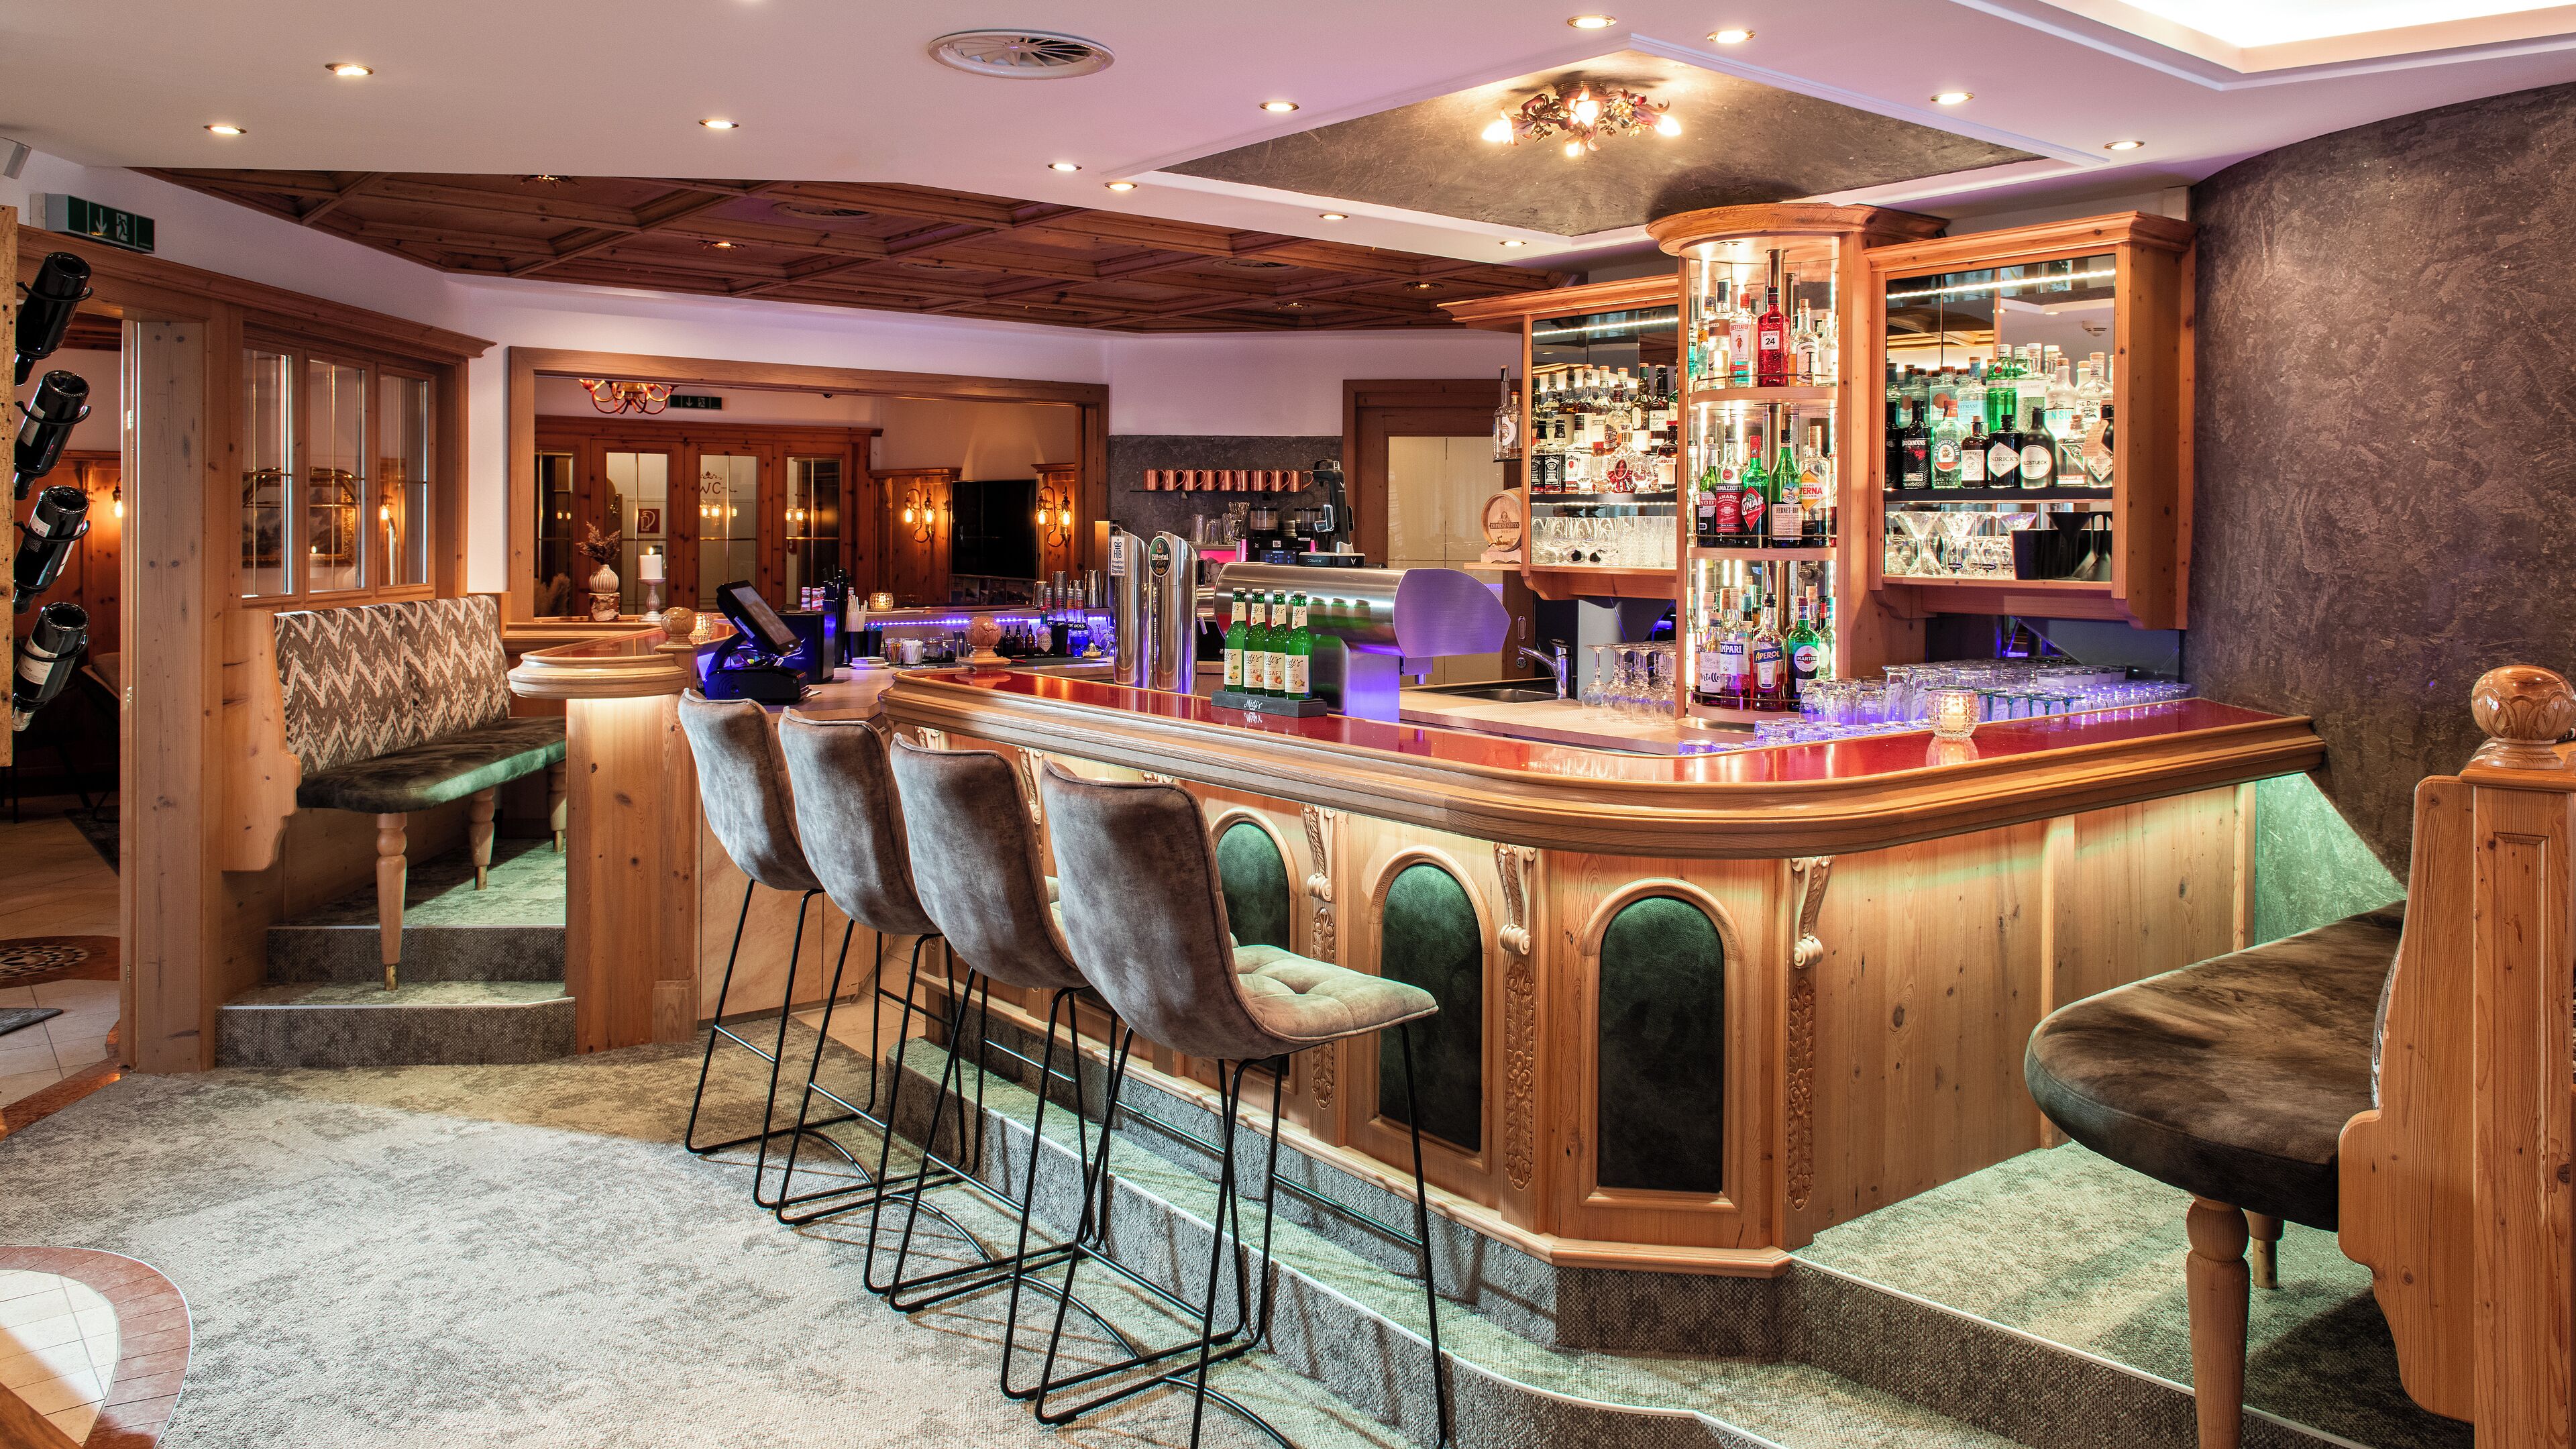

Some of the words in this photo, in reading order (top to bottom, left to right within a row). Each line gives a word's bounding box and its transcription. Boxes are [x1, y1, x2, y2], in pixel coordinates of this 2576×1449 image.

[1765, 337, 1776, 345] 24
[1933, 439, 1955, 456] PLYMOUTH
[700, 482, 721, 494] WC
[1755, 650, 1780, 661] APEROL
[1243, 698, 1263, 710] Midi's
